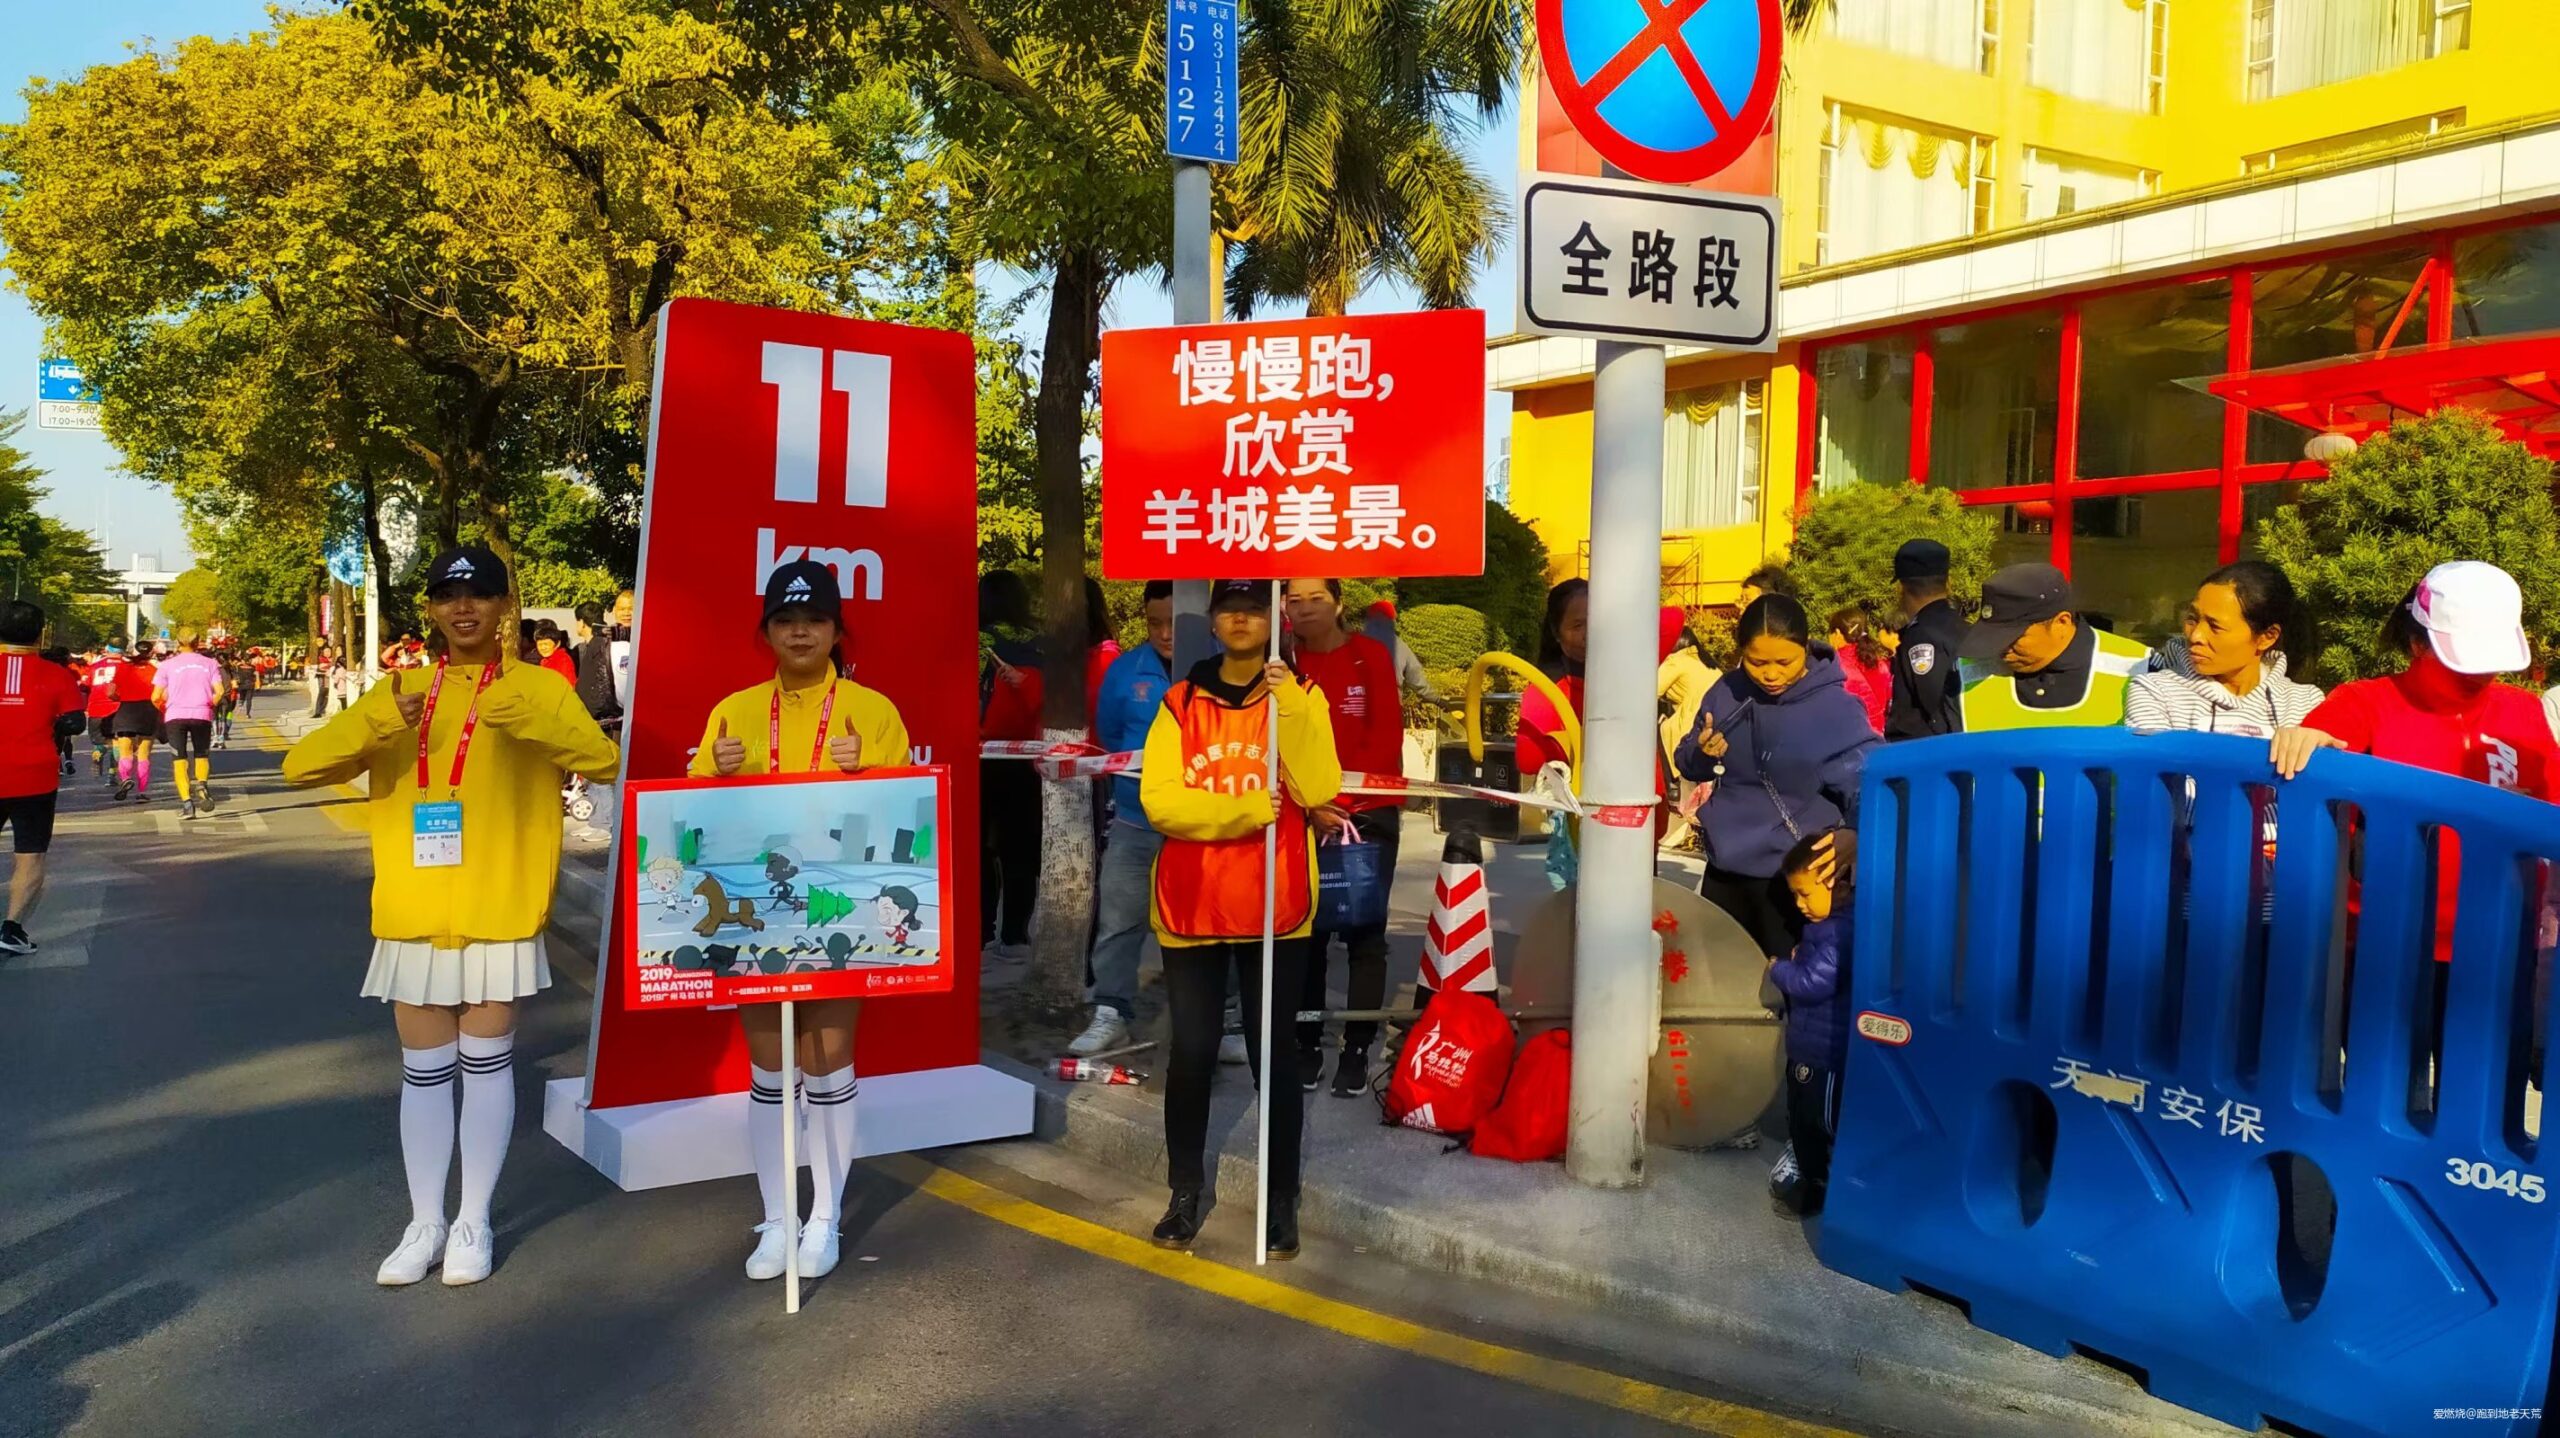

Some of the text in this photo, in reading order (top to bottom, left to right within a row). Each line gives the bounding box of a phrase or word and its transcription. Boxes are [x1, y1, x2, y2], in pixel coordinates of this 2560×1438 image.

[1207, 6, 1229, 20] 电话
[1178, 23, 1196, 144] 5127
[1212, 22, 1226, 156] 83112424
[1559, 220, 1741, 310] 全路段
[1172, 333, 1395, 407] 慢慢跑，
[761, 340, 892, 508] 11
[1221, 407, 1355, 479] 欣赏
[1141, 484, 1437, 555] 羊城美景。
[755, 527, 884, 600] km
[640, 967, 673, 982] 2019
[640, 979, 714, 993] MARATHON
[1424, 1050, 1467, 1076] 马拉松
[1435, 1041, 1474, 1064] 广州
[2445, 1157, 2546, 1204] 3045
